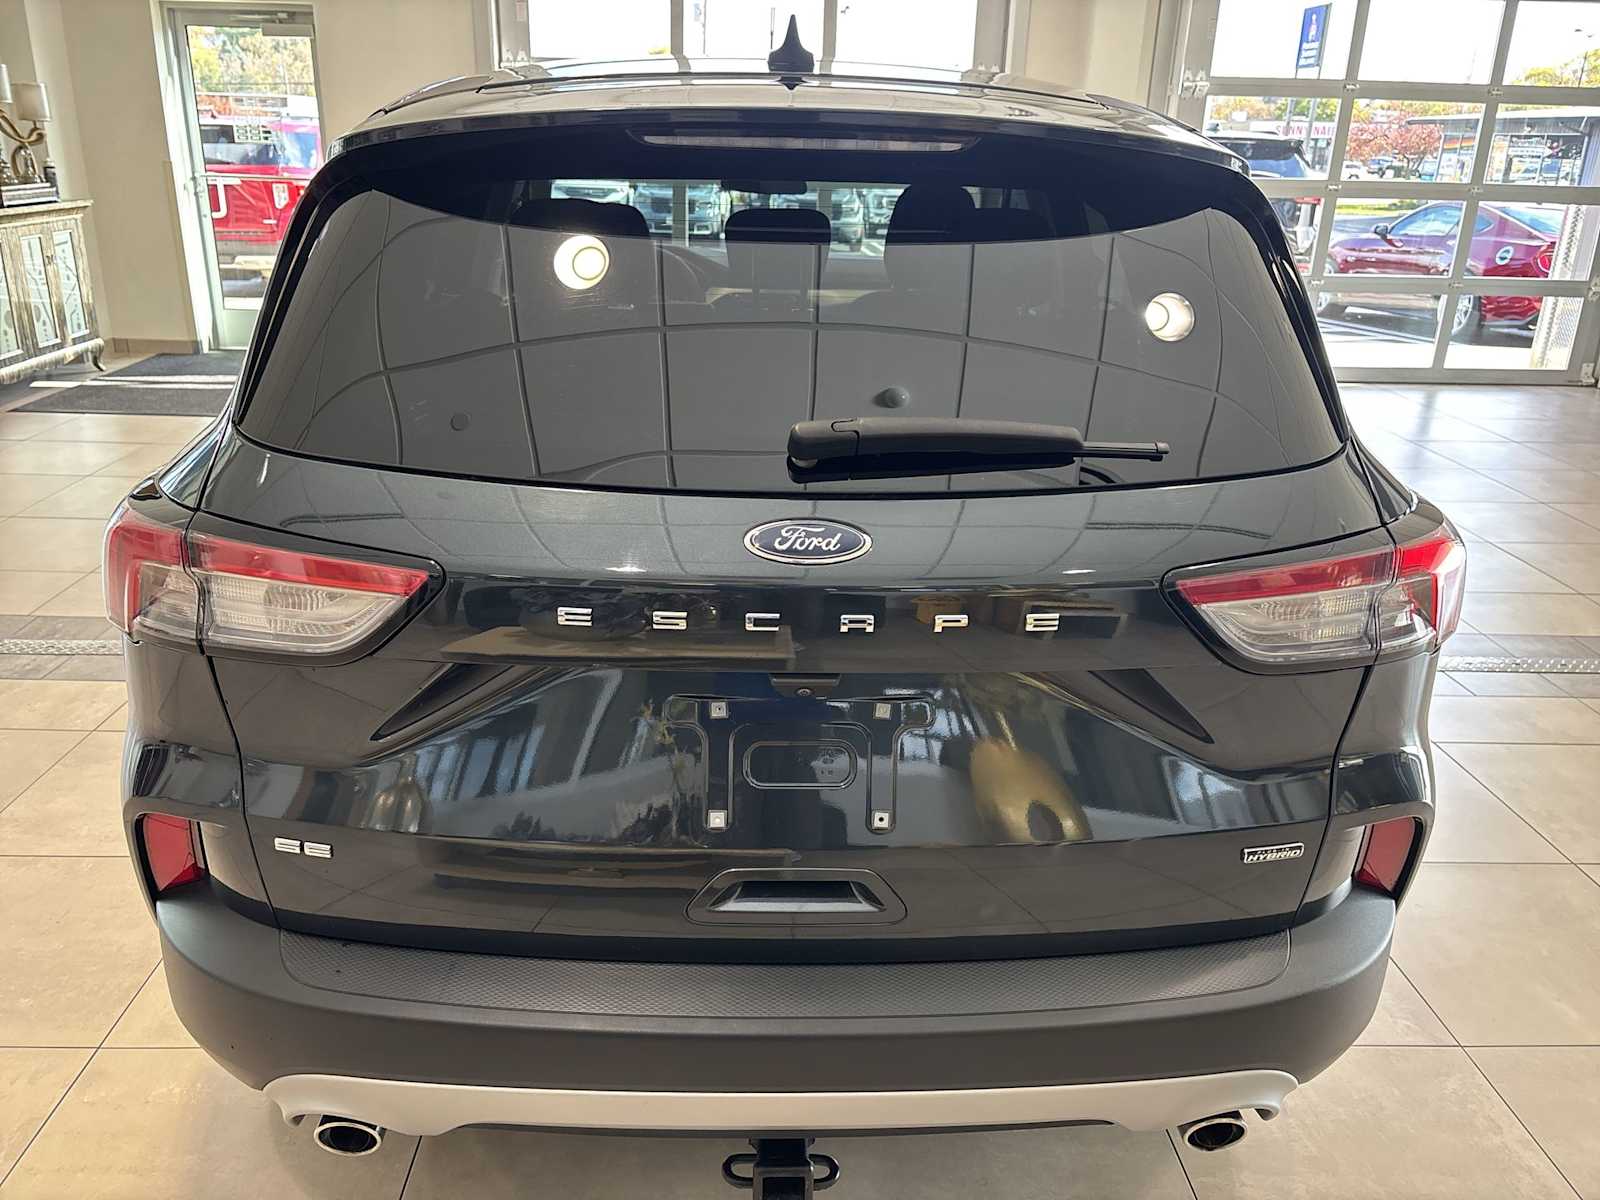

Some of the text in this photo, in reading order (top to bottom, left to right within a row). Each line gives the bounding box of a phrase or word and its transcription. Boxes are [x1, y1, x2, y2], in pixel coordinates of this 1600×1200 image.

[774, 525, 842, 551] Ford
[557, 606, 1060, 633] ESCAPE
[274, 837, 331, 859] SE
[1247, 849, 1301, 862] HYBRID
